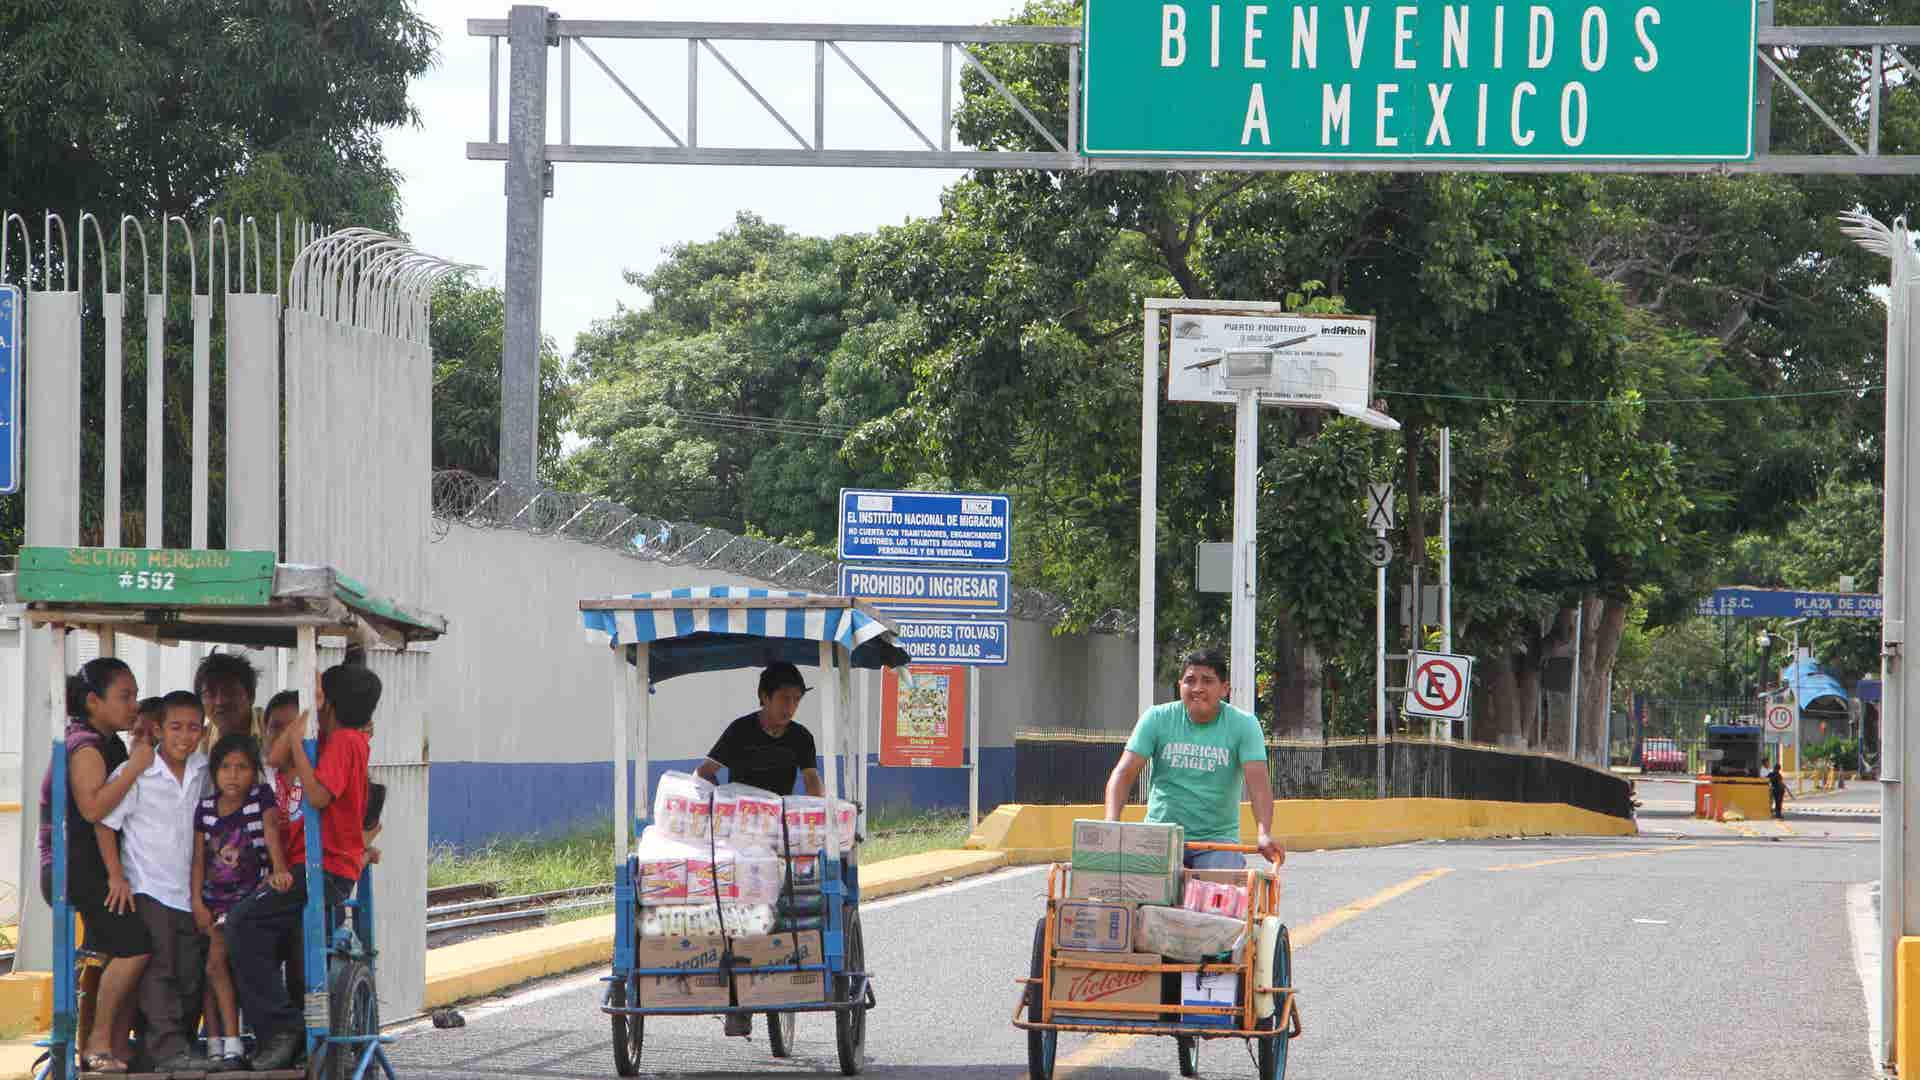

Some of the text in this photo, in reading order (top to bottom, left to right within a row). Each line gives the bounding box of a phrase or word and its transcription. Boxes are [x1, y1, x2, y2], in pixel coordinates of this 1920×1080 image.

[1160, 5, 1661, 73] BIENVENIDOS
[1241, 81, 1589, 148] A MEXICO
[1224, 323, 1307, 334] PUERTO FRONTERIZO
[847, 511, 1004, 529] EL INSTITUTO NACIONAL DE MIGRACION
[848, 527, 858, 536] NO
[858, 527, 885, 537] CUENTA
[886, 529, 899, 537] CON
[895, 538, 909, 546] LOS
[69, 548, 136, 567] SECTOR
[1375, 543, 1386, 560] 3
[851, 573, 999, 598] PROHIBIDO INGRESAR
[1795, 598, 1832, 609] PLAZA
[1838, 599, 1854, 609] DE
[899, 624, 999, 642] RGADORES (TOLVAS)
[903, 643, 981, 657] IONES O BALAS
[1161, 742, 1230, 767] AMERICAN
[1170, 755, 1216, 772] EAGLE
